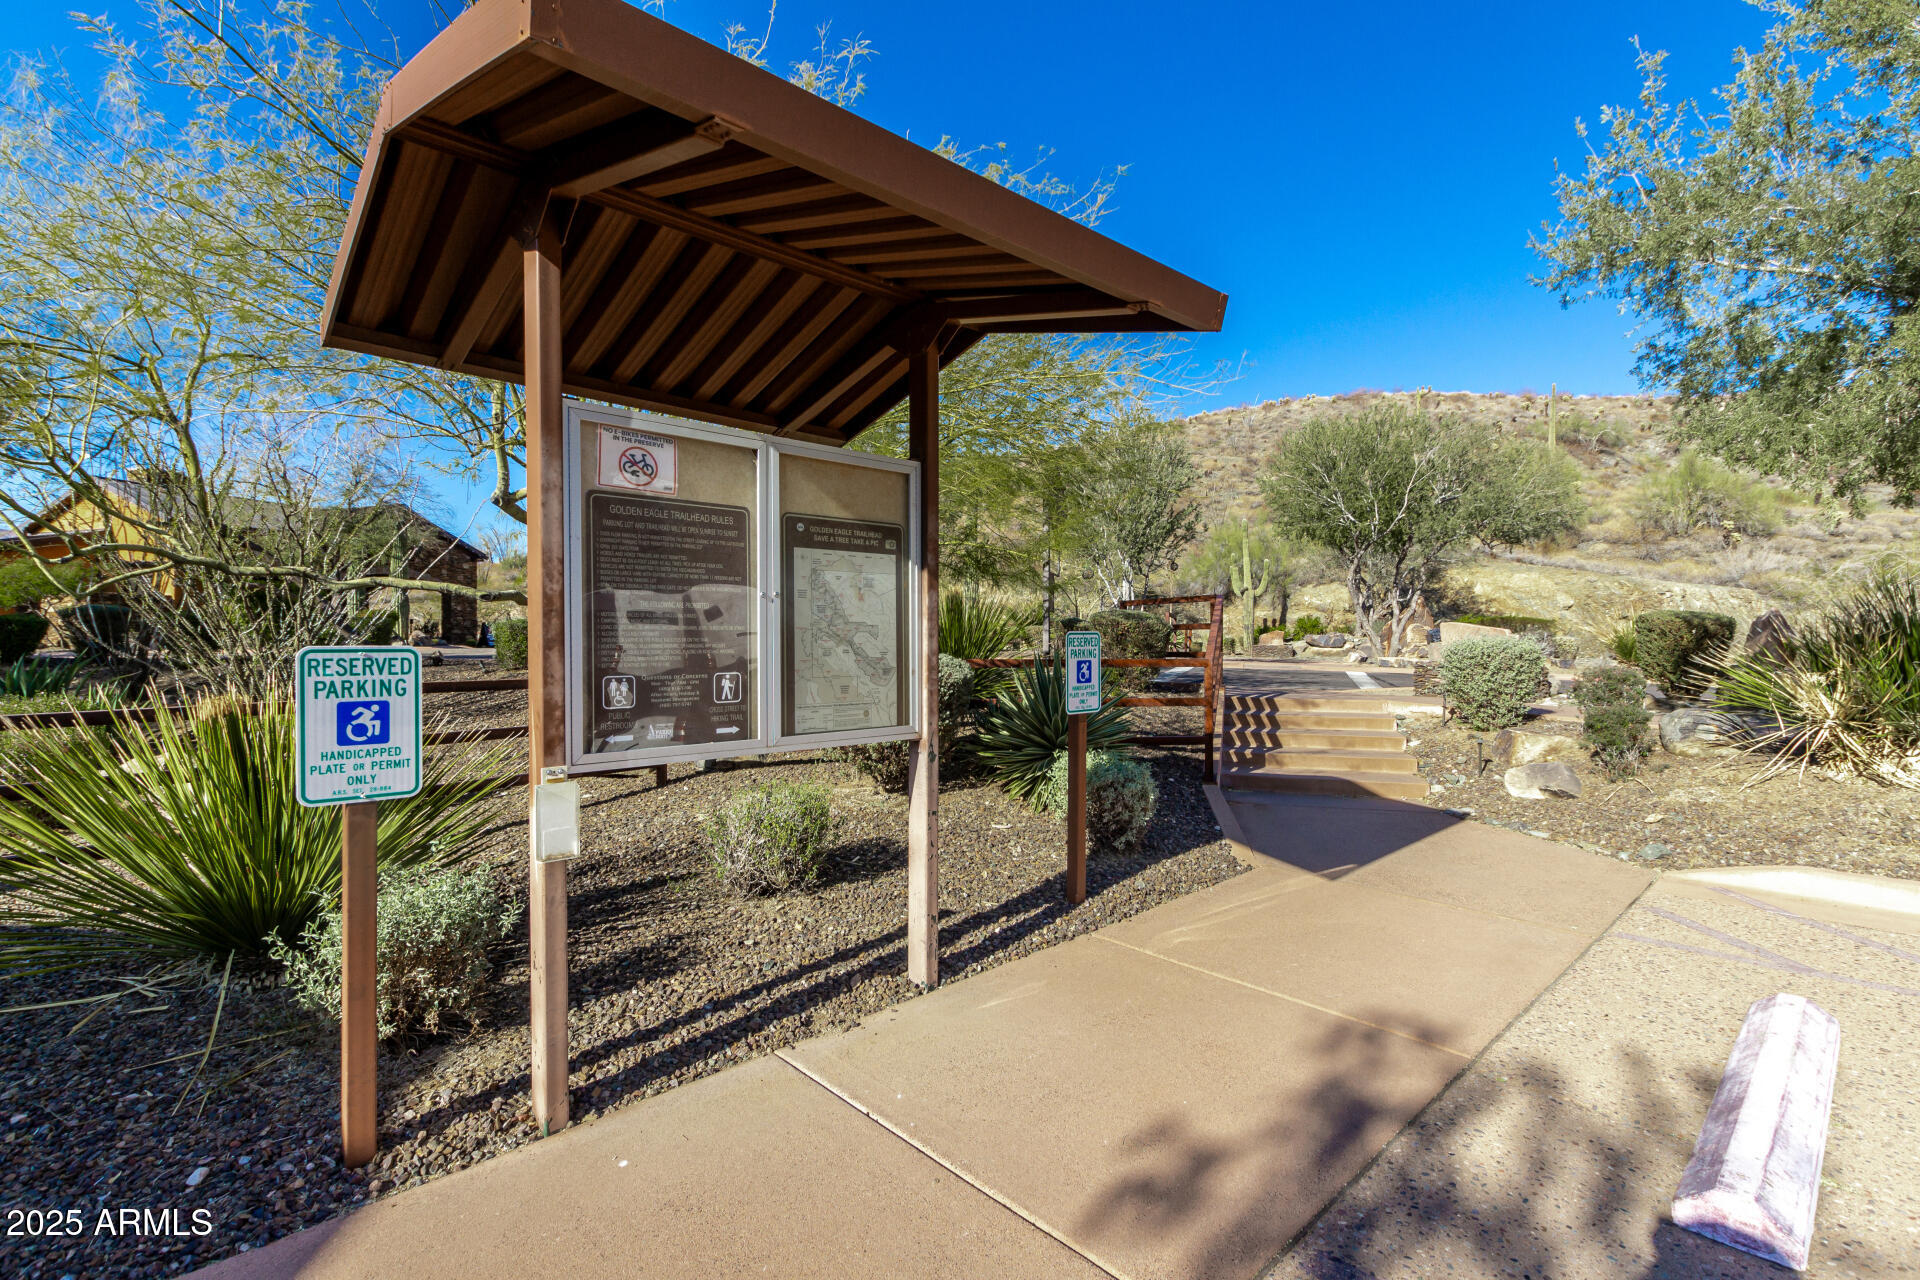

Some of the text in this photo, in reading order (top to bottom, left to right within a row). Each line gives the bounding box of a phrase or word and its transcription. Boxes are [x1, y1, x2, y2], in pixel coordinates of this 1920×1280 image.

[614, 429, 639, 438] E-BIKES
[621, 436, 633, 444] THE
[634, 438, 664, 448] PRESERVE
[609, 504, 734, 525] GOLDEN EAGLE TRAILHEAD RULES
[809, 526, 834, 534] GOLDEN
[834, 528, 853, 536] EAGLE
[1069, 637, 1098, 647] RESERVED
[1071, 649, 1096, 658] PARKING
[308, 658, 412, 677] RESERVED
[314, 679, 407, 699] PARKING
[608, 711, 631, 720] PUBLIC
[320, 746, 402, 762] HANDICAPPED
[310, 758, 411, 775] PLATE OR PERMIT
[347, 774, 377, 786] ONLY
